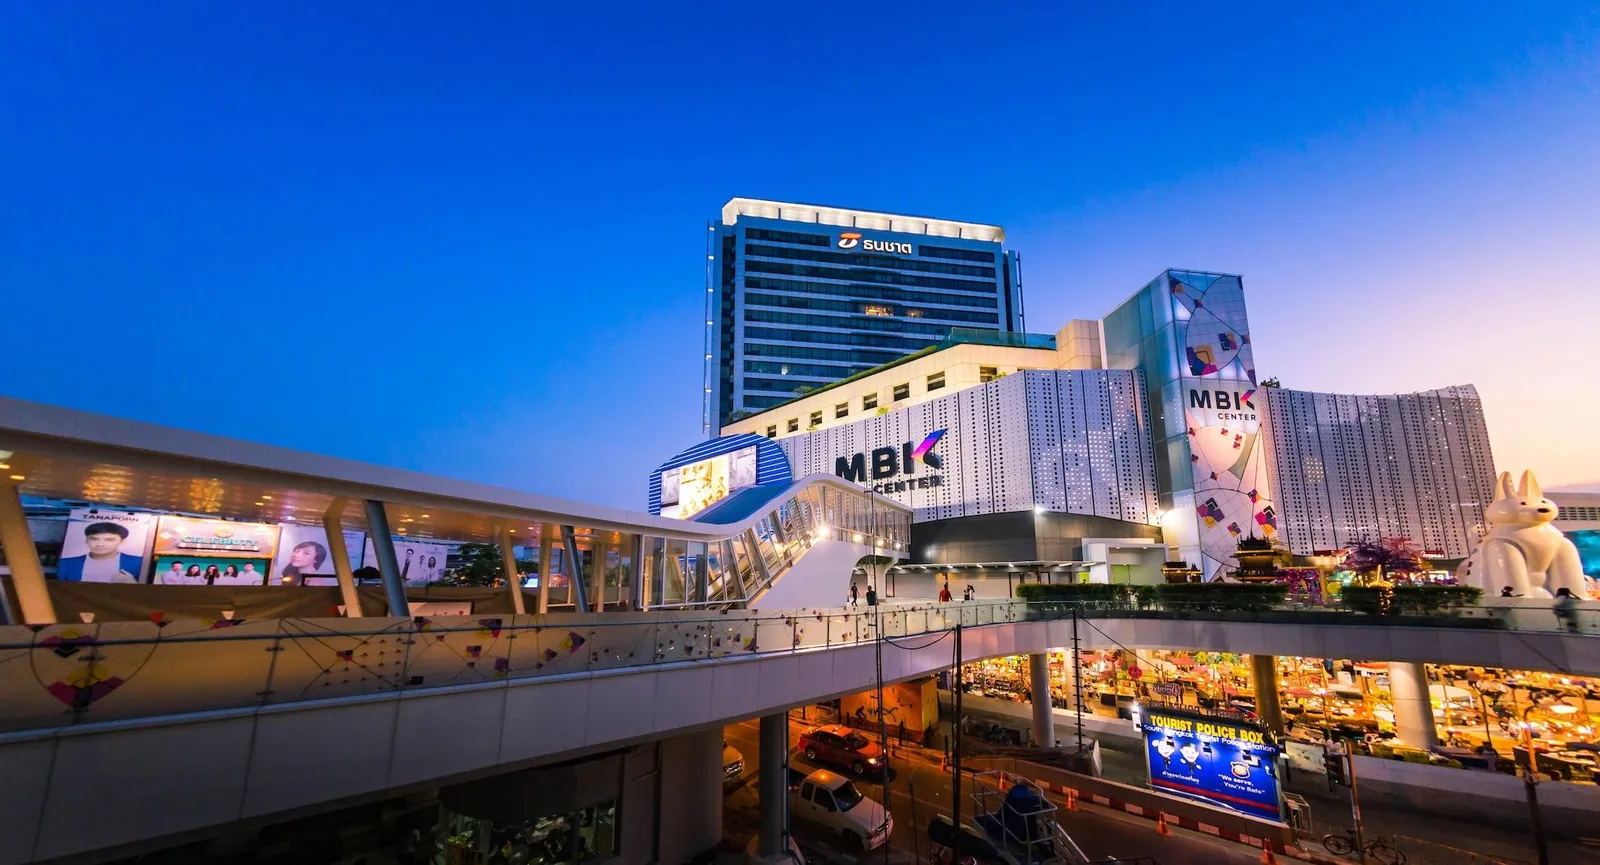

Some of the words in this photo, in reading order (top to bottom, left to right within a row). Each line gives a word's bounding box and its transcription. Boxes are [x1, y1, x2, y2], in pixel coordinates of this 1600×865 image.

[863, 239, 912, 254] ธนชาต
[1190, 389, 1256, 411] MBK
[1217, 413, 1257, 421] CENTER
[835, 428, 949, 483] MBK
[873, 475, 944, 495] CENTER
[82, 514, 139, 522] TANAPORN
[1144, 724, 1163, 733] South
[1164, 727, 1194, 738] ngkok
[1195, 732, 1219, 742] Trist
[1221, 737, 1244, 749] Polic
[1247, 741, 1276, 753] Station
[1150, 715, 1193, 732] TOURIST
[1196, 722, 1236, 739] POLICE
[1240, 729, 1265, 745] BOX
[1223, 781, 1245, 791] You're
